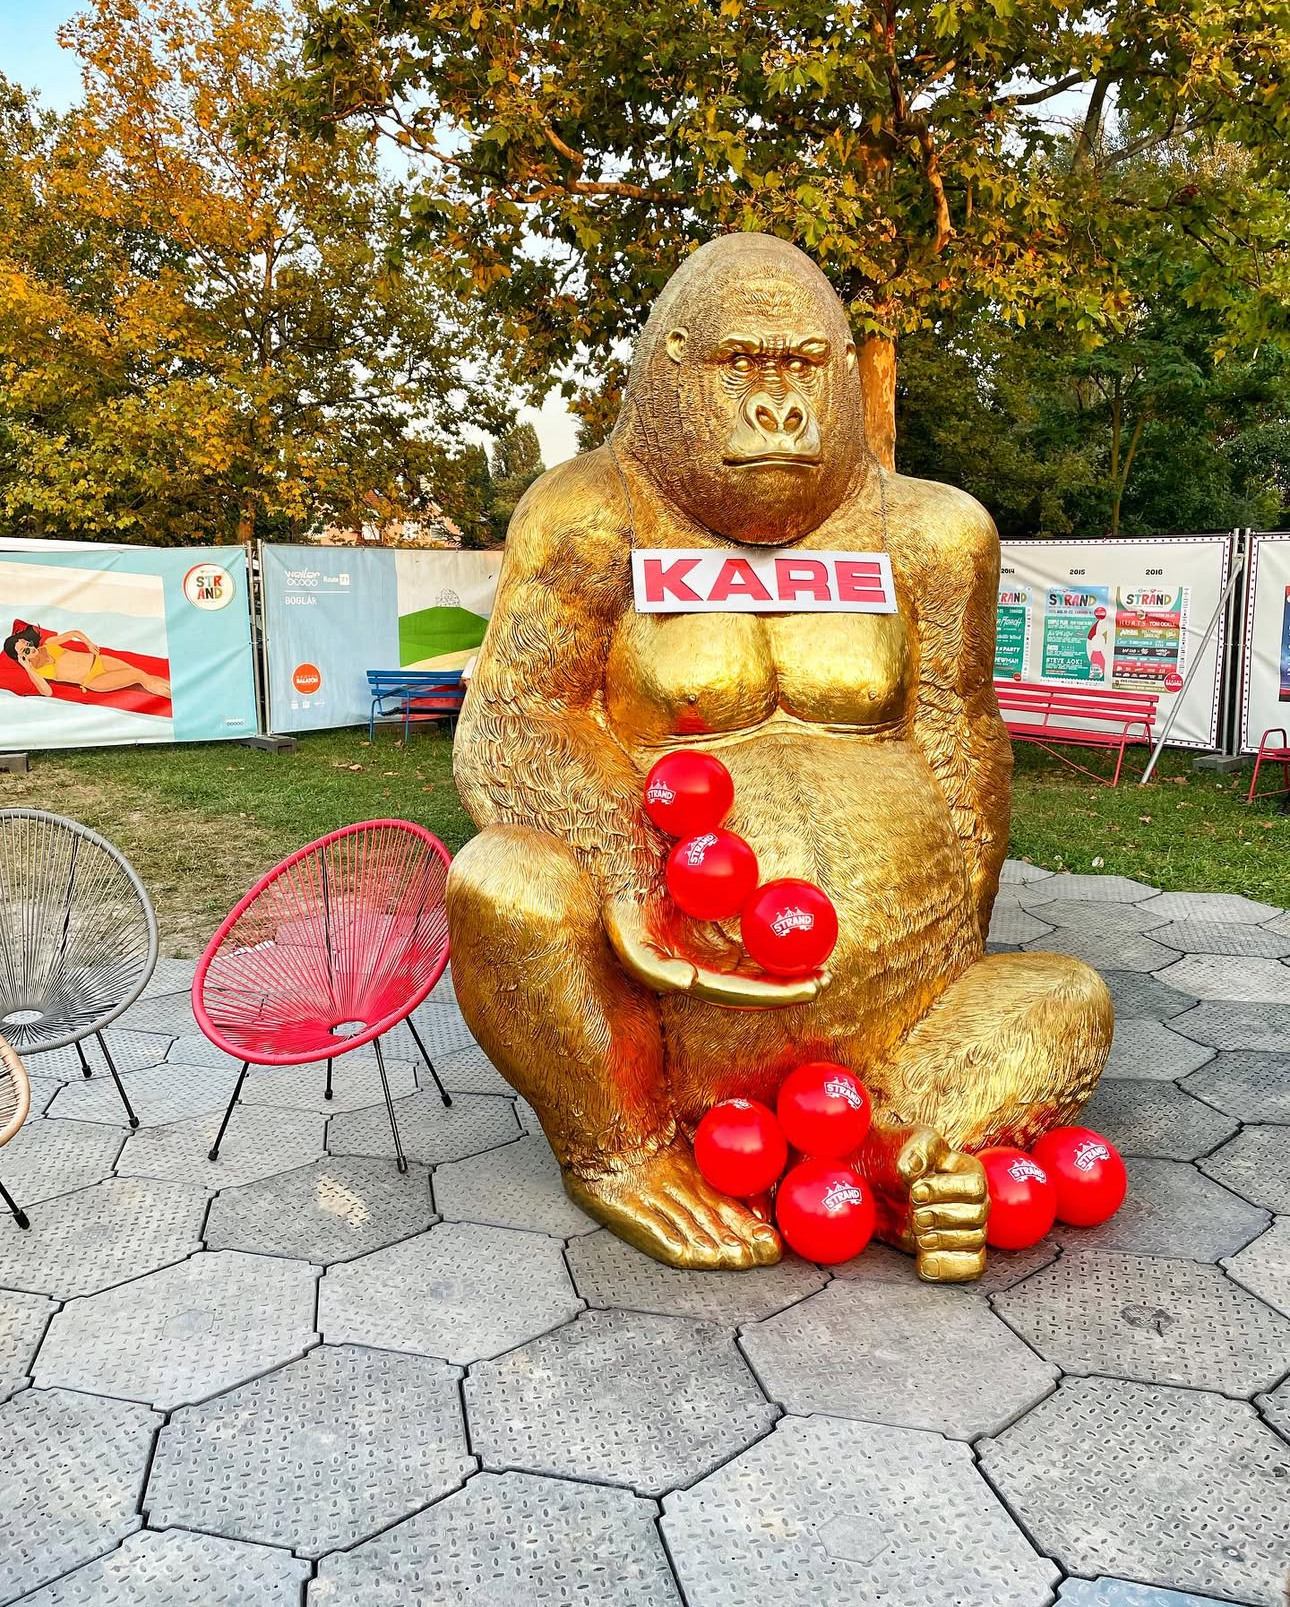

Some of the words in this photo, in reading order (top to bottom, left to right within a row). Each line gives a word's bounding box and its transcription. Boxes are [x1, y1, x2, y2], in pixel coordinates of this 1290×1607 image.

[196, 575, 223, 588] STR
[643, 558, 887, 604] KARE
[197, 587, 223, 600] AND
[285, 594, 317, 605] BOGLÁR
[1049, 593, 1097, 607] STRAND
[1126, 594, 1172, 606] STRAND
[647, 789, 673, 801] STRAND
[689, 833, 715, 864] STRAND
[773, 915, 813, 933] STRAND
[826, 1083, 861, 1105] STRAND
[1079, 1147, 1106, 1168] STRAND
[1013, 1167, 1045, 1178] STRAND
[825, 1189, 860, 1207] STRAND
